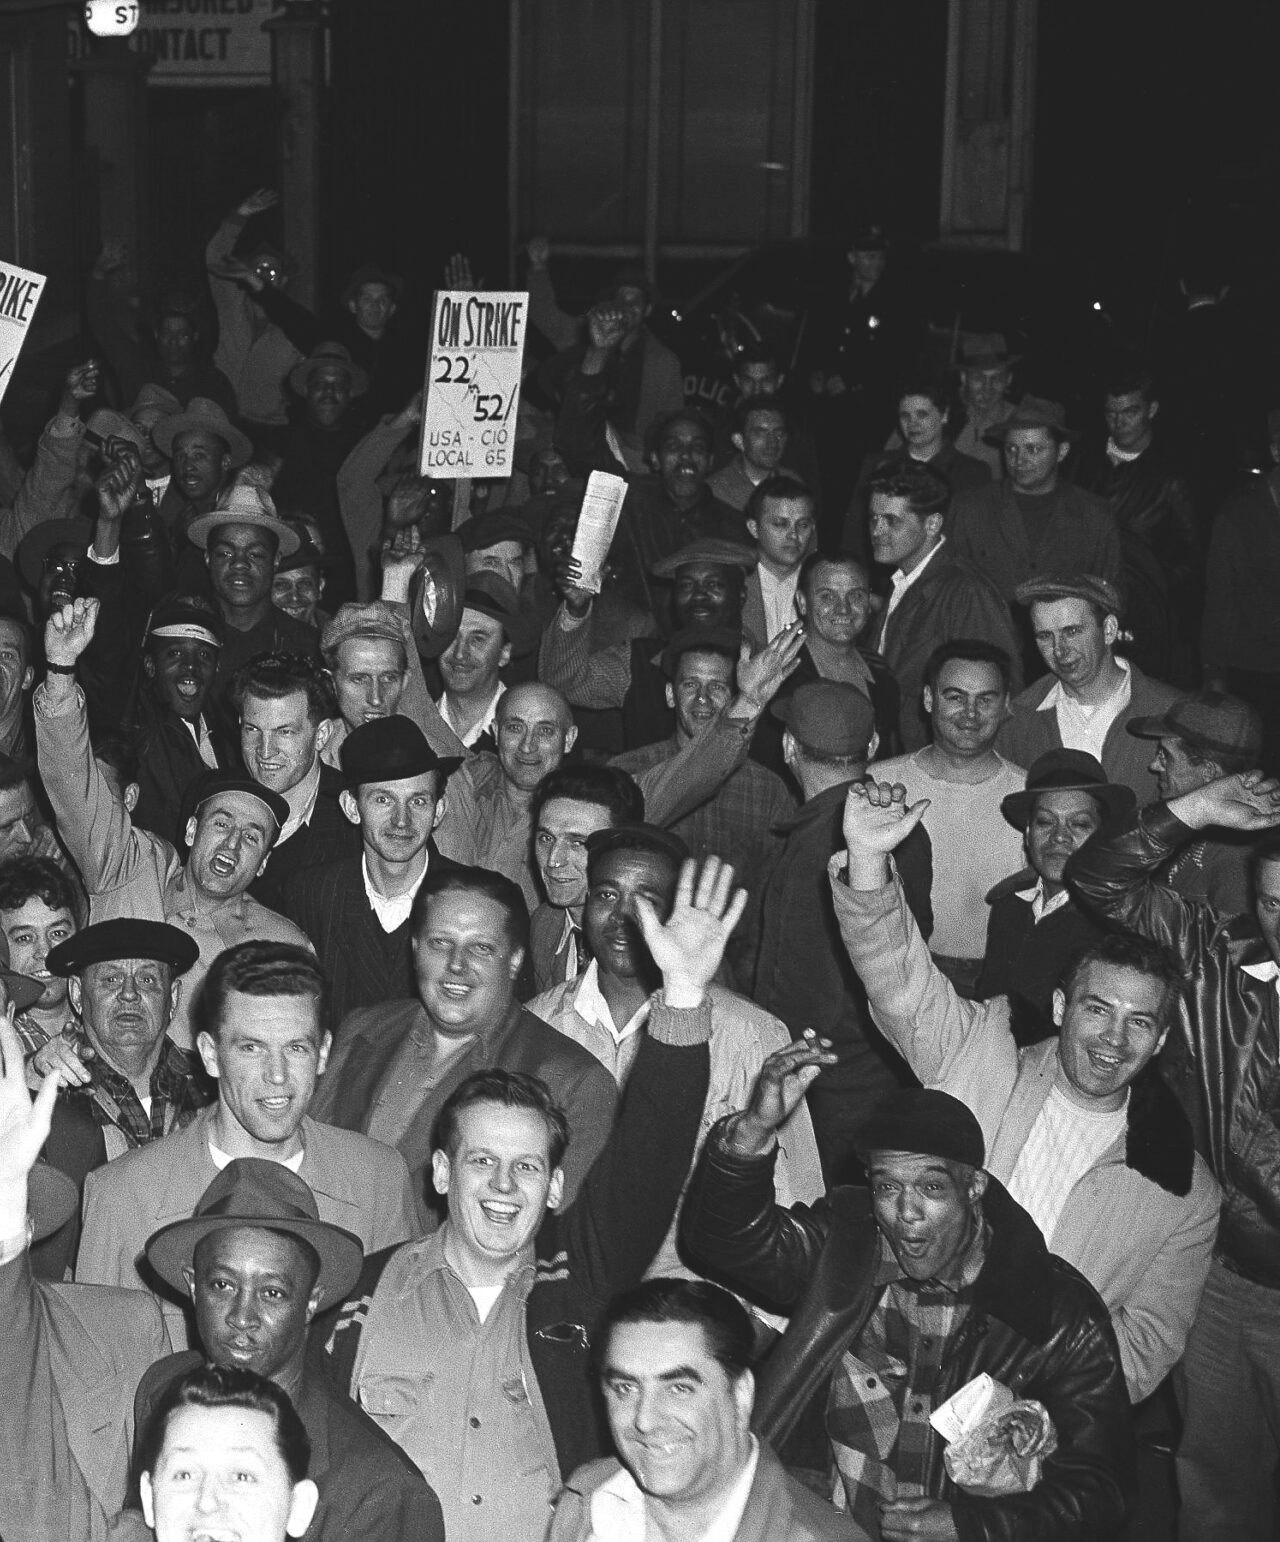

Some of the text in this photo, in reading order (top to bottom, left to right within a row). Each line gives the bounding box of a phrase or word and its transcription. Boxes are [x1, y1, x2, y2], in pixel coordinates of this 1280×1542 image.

[438, 296, 523, 347] ON STRIKE
[429, 430, 462, 447] USA
[481, 429, 508, 446] CIO
[427, 449, 507, 467] LOCAL 65
